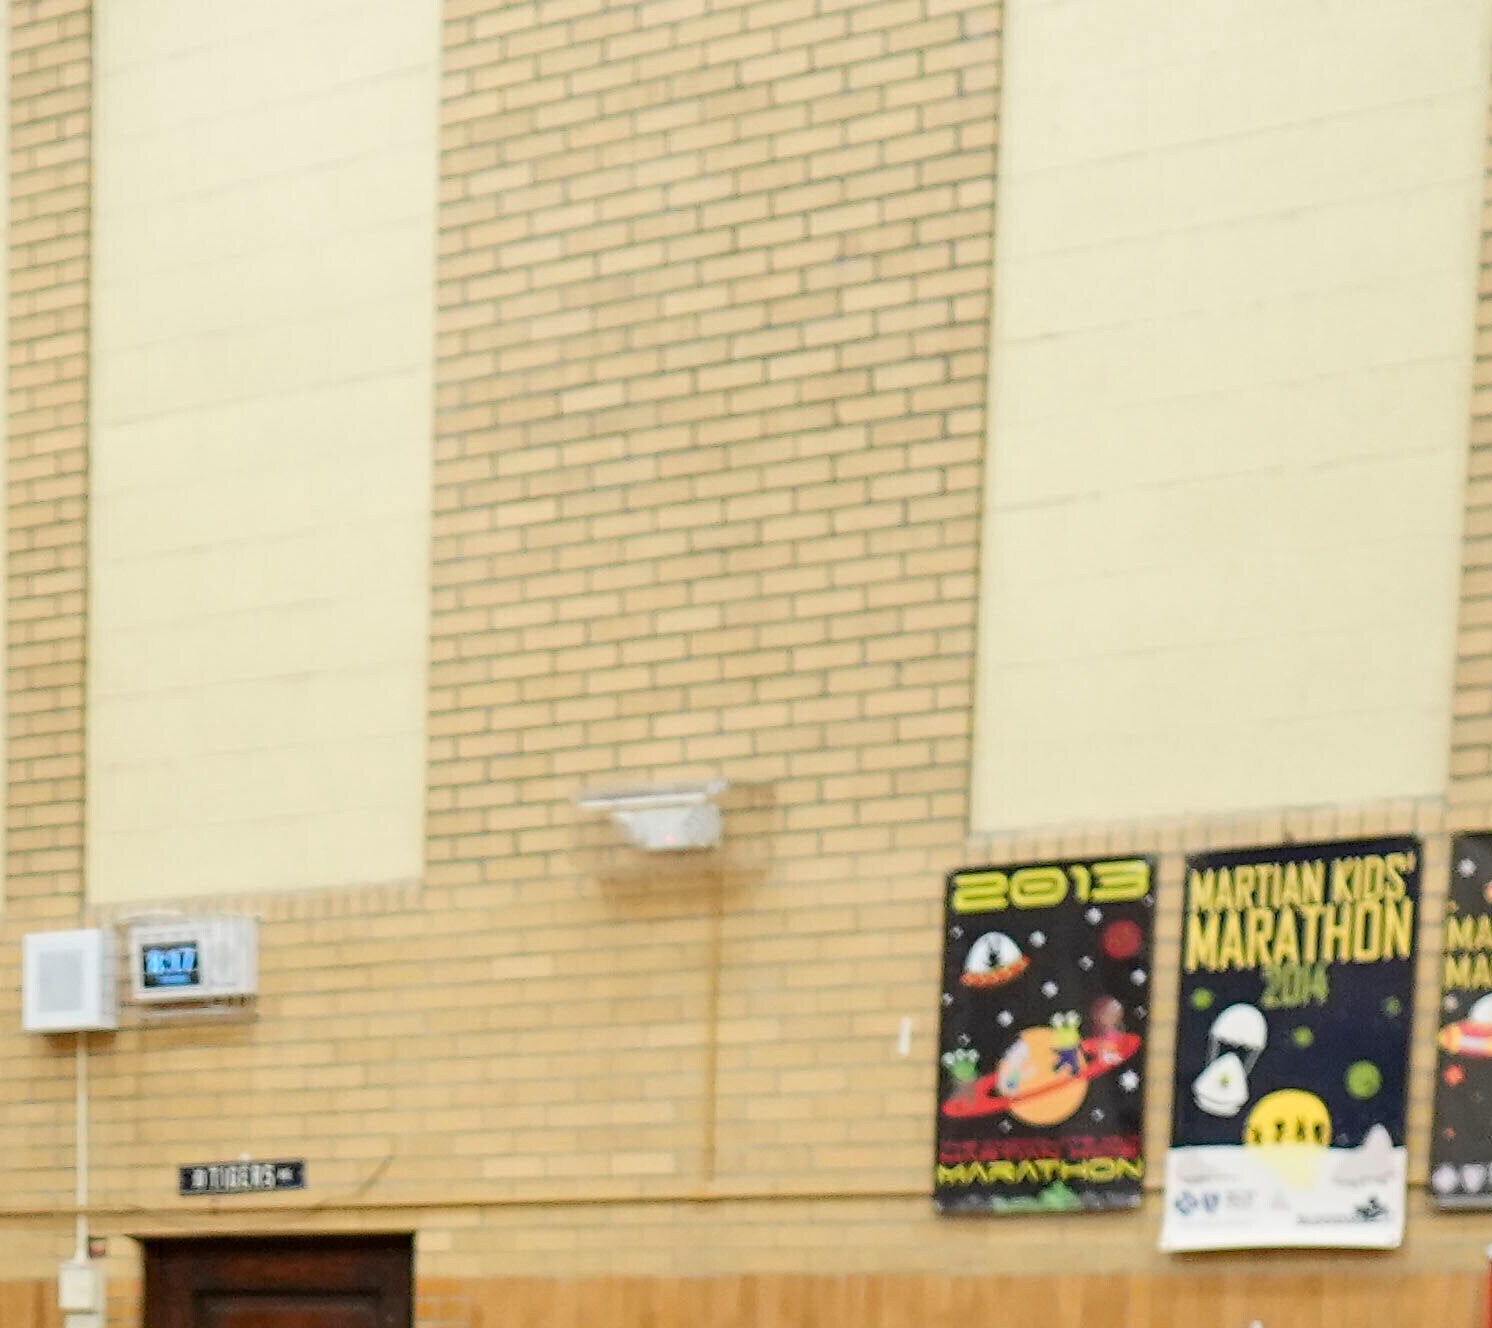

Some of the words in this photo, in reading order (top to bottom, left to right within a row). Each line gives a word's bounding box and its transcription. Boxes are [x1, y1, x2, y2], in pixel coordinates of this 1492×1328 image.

[953, 858, 1151, 914] 2013
[1190, 859, 1325, 912] MARTIAN
[1185, 900, 1414, 972] MARATHON
[937, 1156, 1144, 1186] MARATHON
